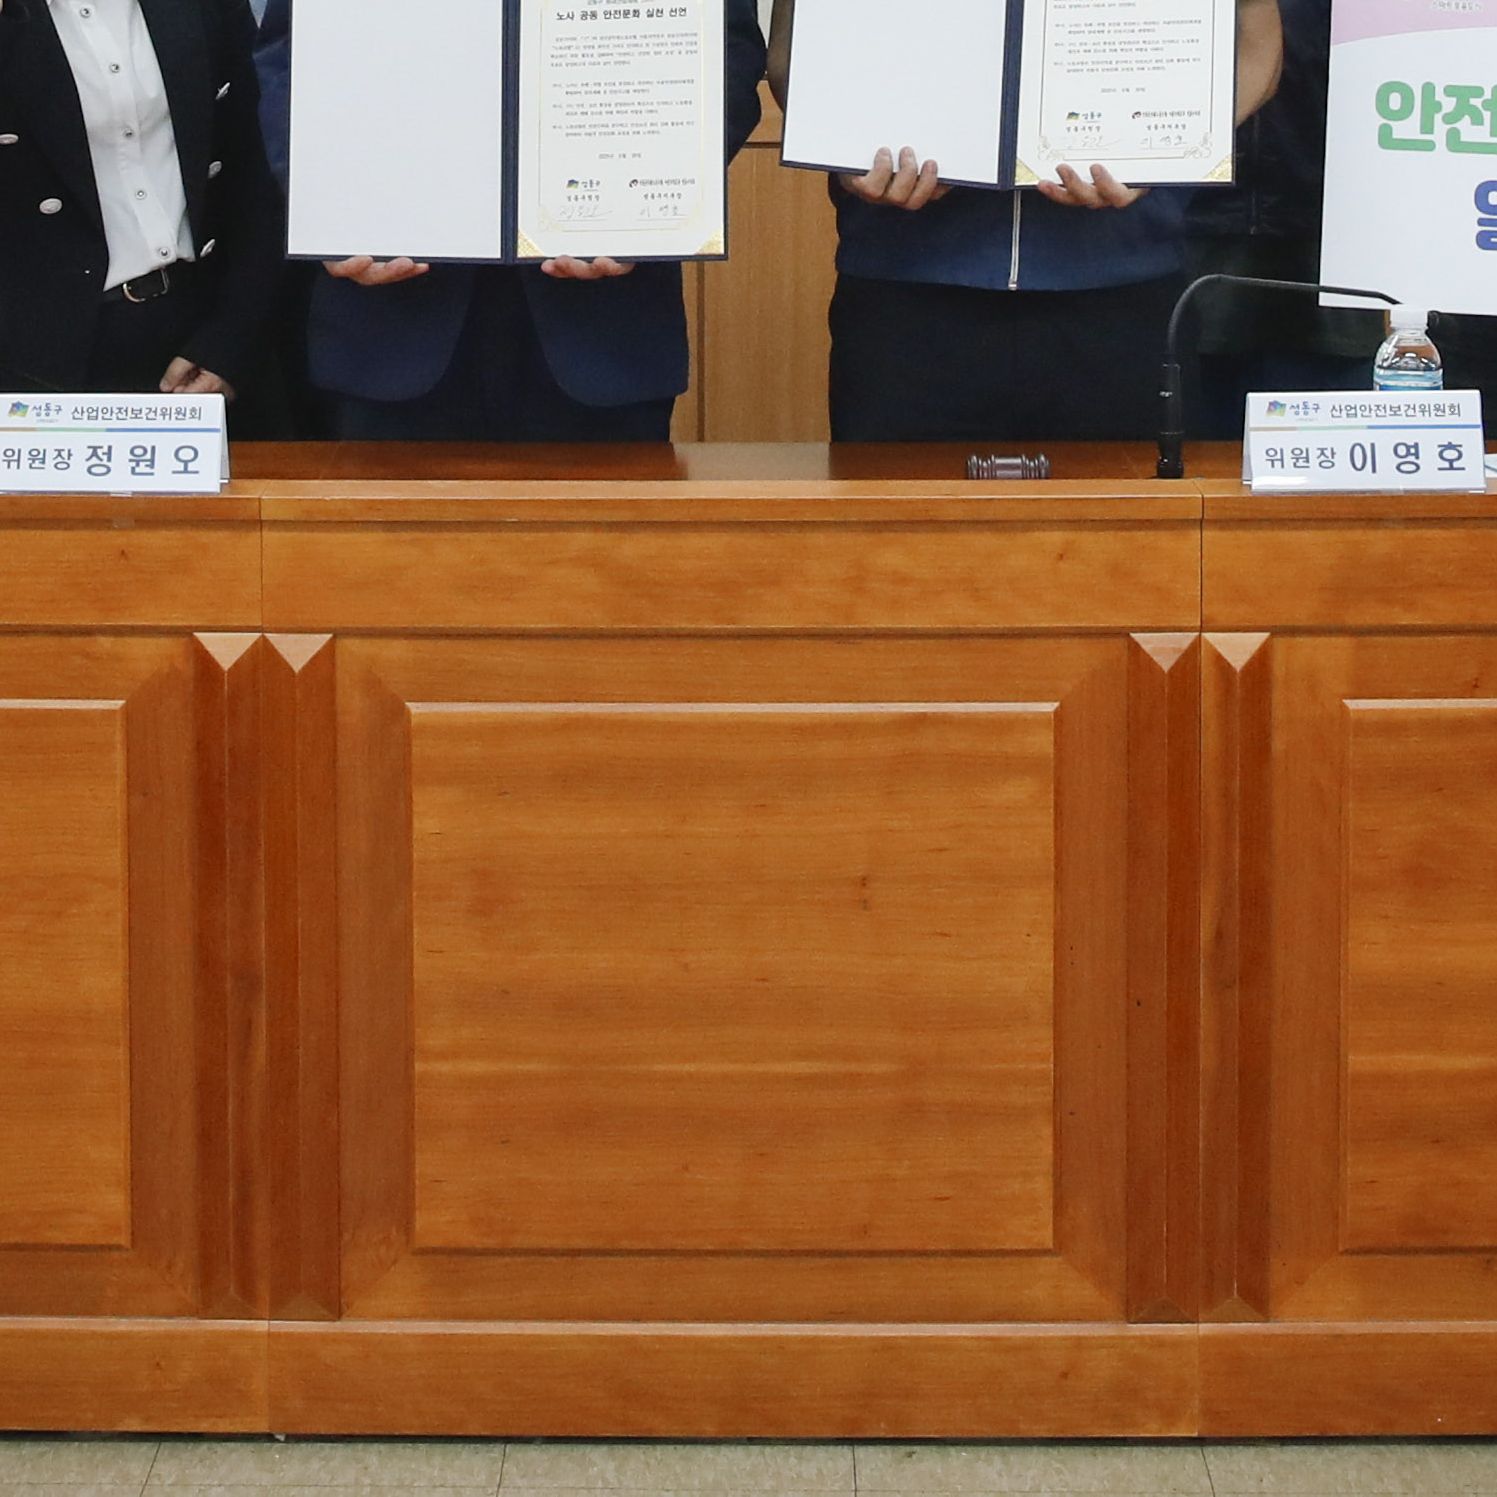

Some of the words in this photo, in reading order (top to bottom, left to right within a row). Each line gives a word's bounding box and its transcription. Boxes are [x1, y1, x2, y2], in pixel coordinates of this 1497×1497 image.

[556, 11, 575, 21] 노사
[579, 10, 598, 21] 공동
[603, 9, 641, 20] 안전문화
[646, 8, 664, 18] 실천
[669, 7, 687, 17] 선언
[32, 402, 63, 417] 성동구
[71, 405, 203, 421] 산업안전보건위원회
[1289, 401, 1321, 416] 성동구
[1329, 402, 1461, 418] 산업안전보건위원회
[2, 448, 73, 471] 위원장
[1265, 447, 1337, 469] 위원장
